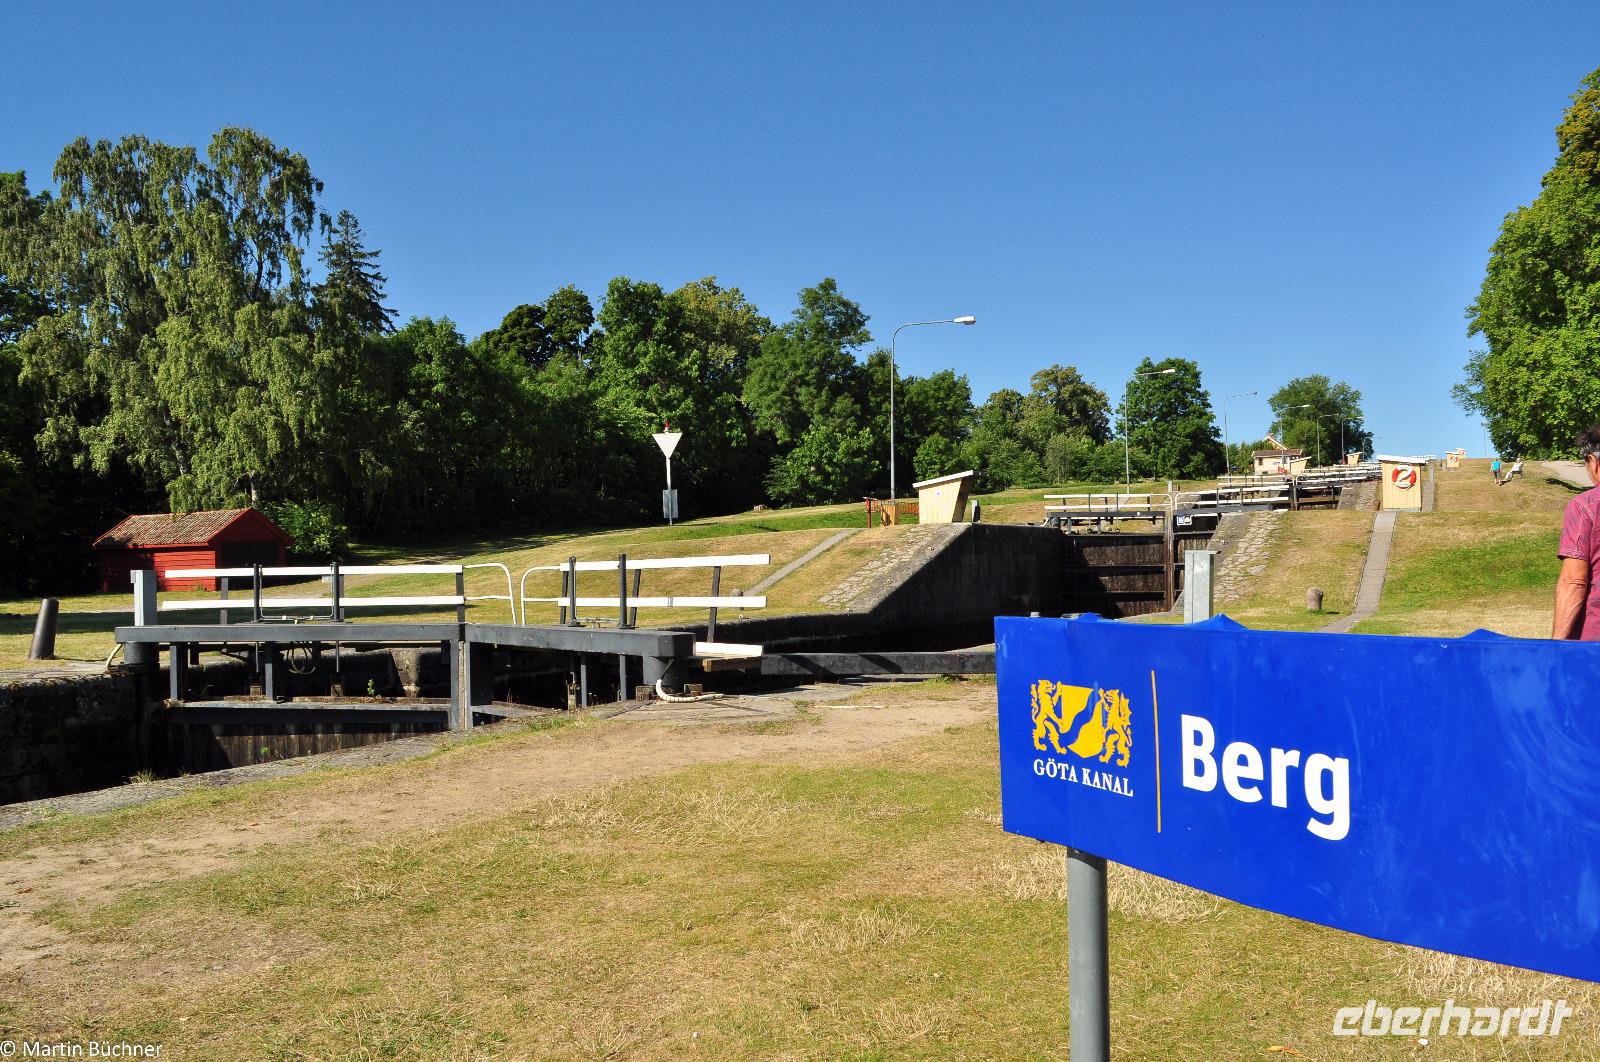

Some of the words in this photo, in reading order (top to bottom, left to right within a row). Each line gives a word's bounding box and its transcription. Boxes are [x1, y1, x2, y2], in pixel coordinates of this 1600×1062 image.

[1033, 757, 1079, 783] GÖTA
[1081, 768, 1134, 797] KANAL
[1181, 713, 1350, 841] Berg
